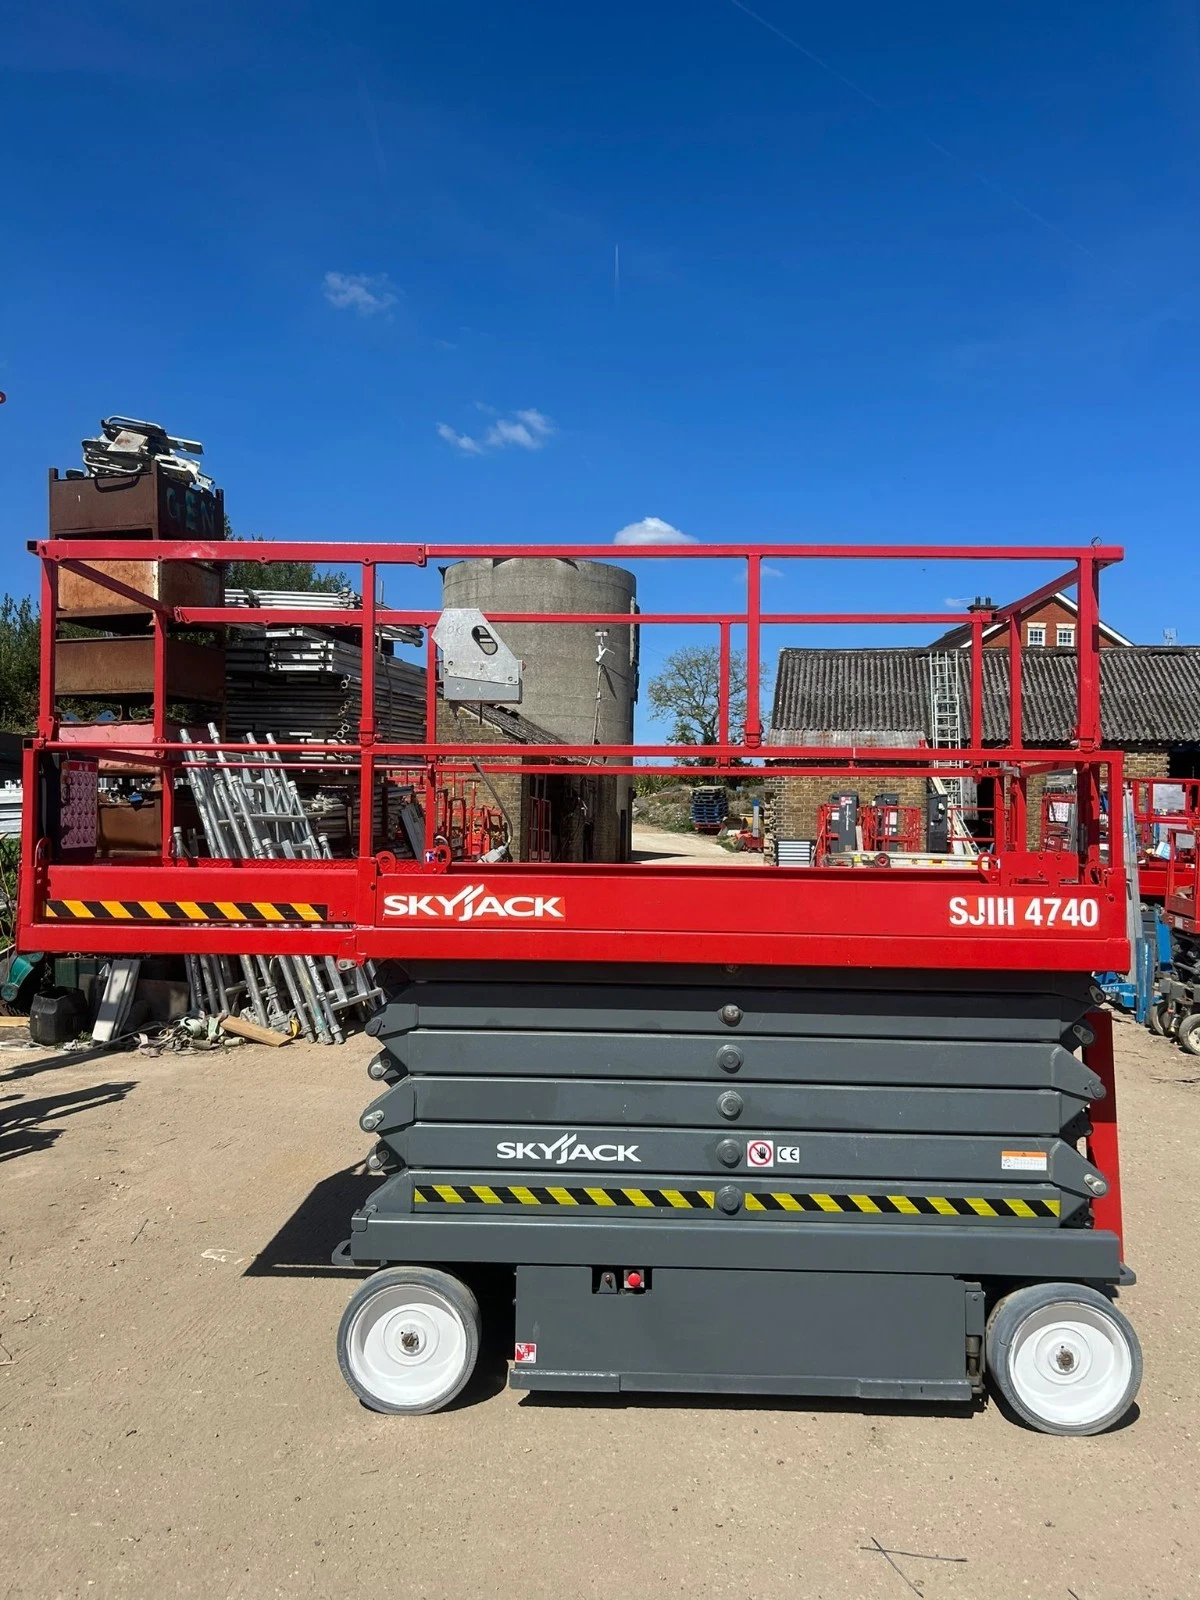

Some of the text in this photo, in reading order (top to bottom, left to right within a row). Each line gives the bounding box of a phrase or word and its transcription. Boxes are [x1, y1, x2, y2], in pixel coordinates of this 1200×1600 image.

[383, 884, 565, 922] SKYJACK
[1024, 897, 1098, 927] 4740
[496, 1133, 641, 1165] SKYJACK
[779, 1147, 798, 1161] CE
